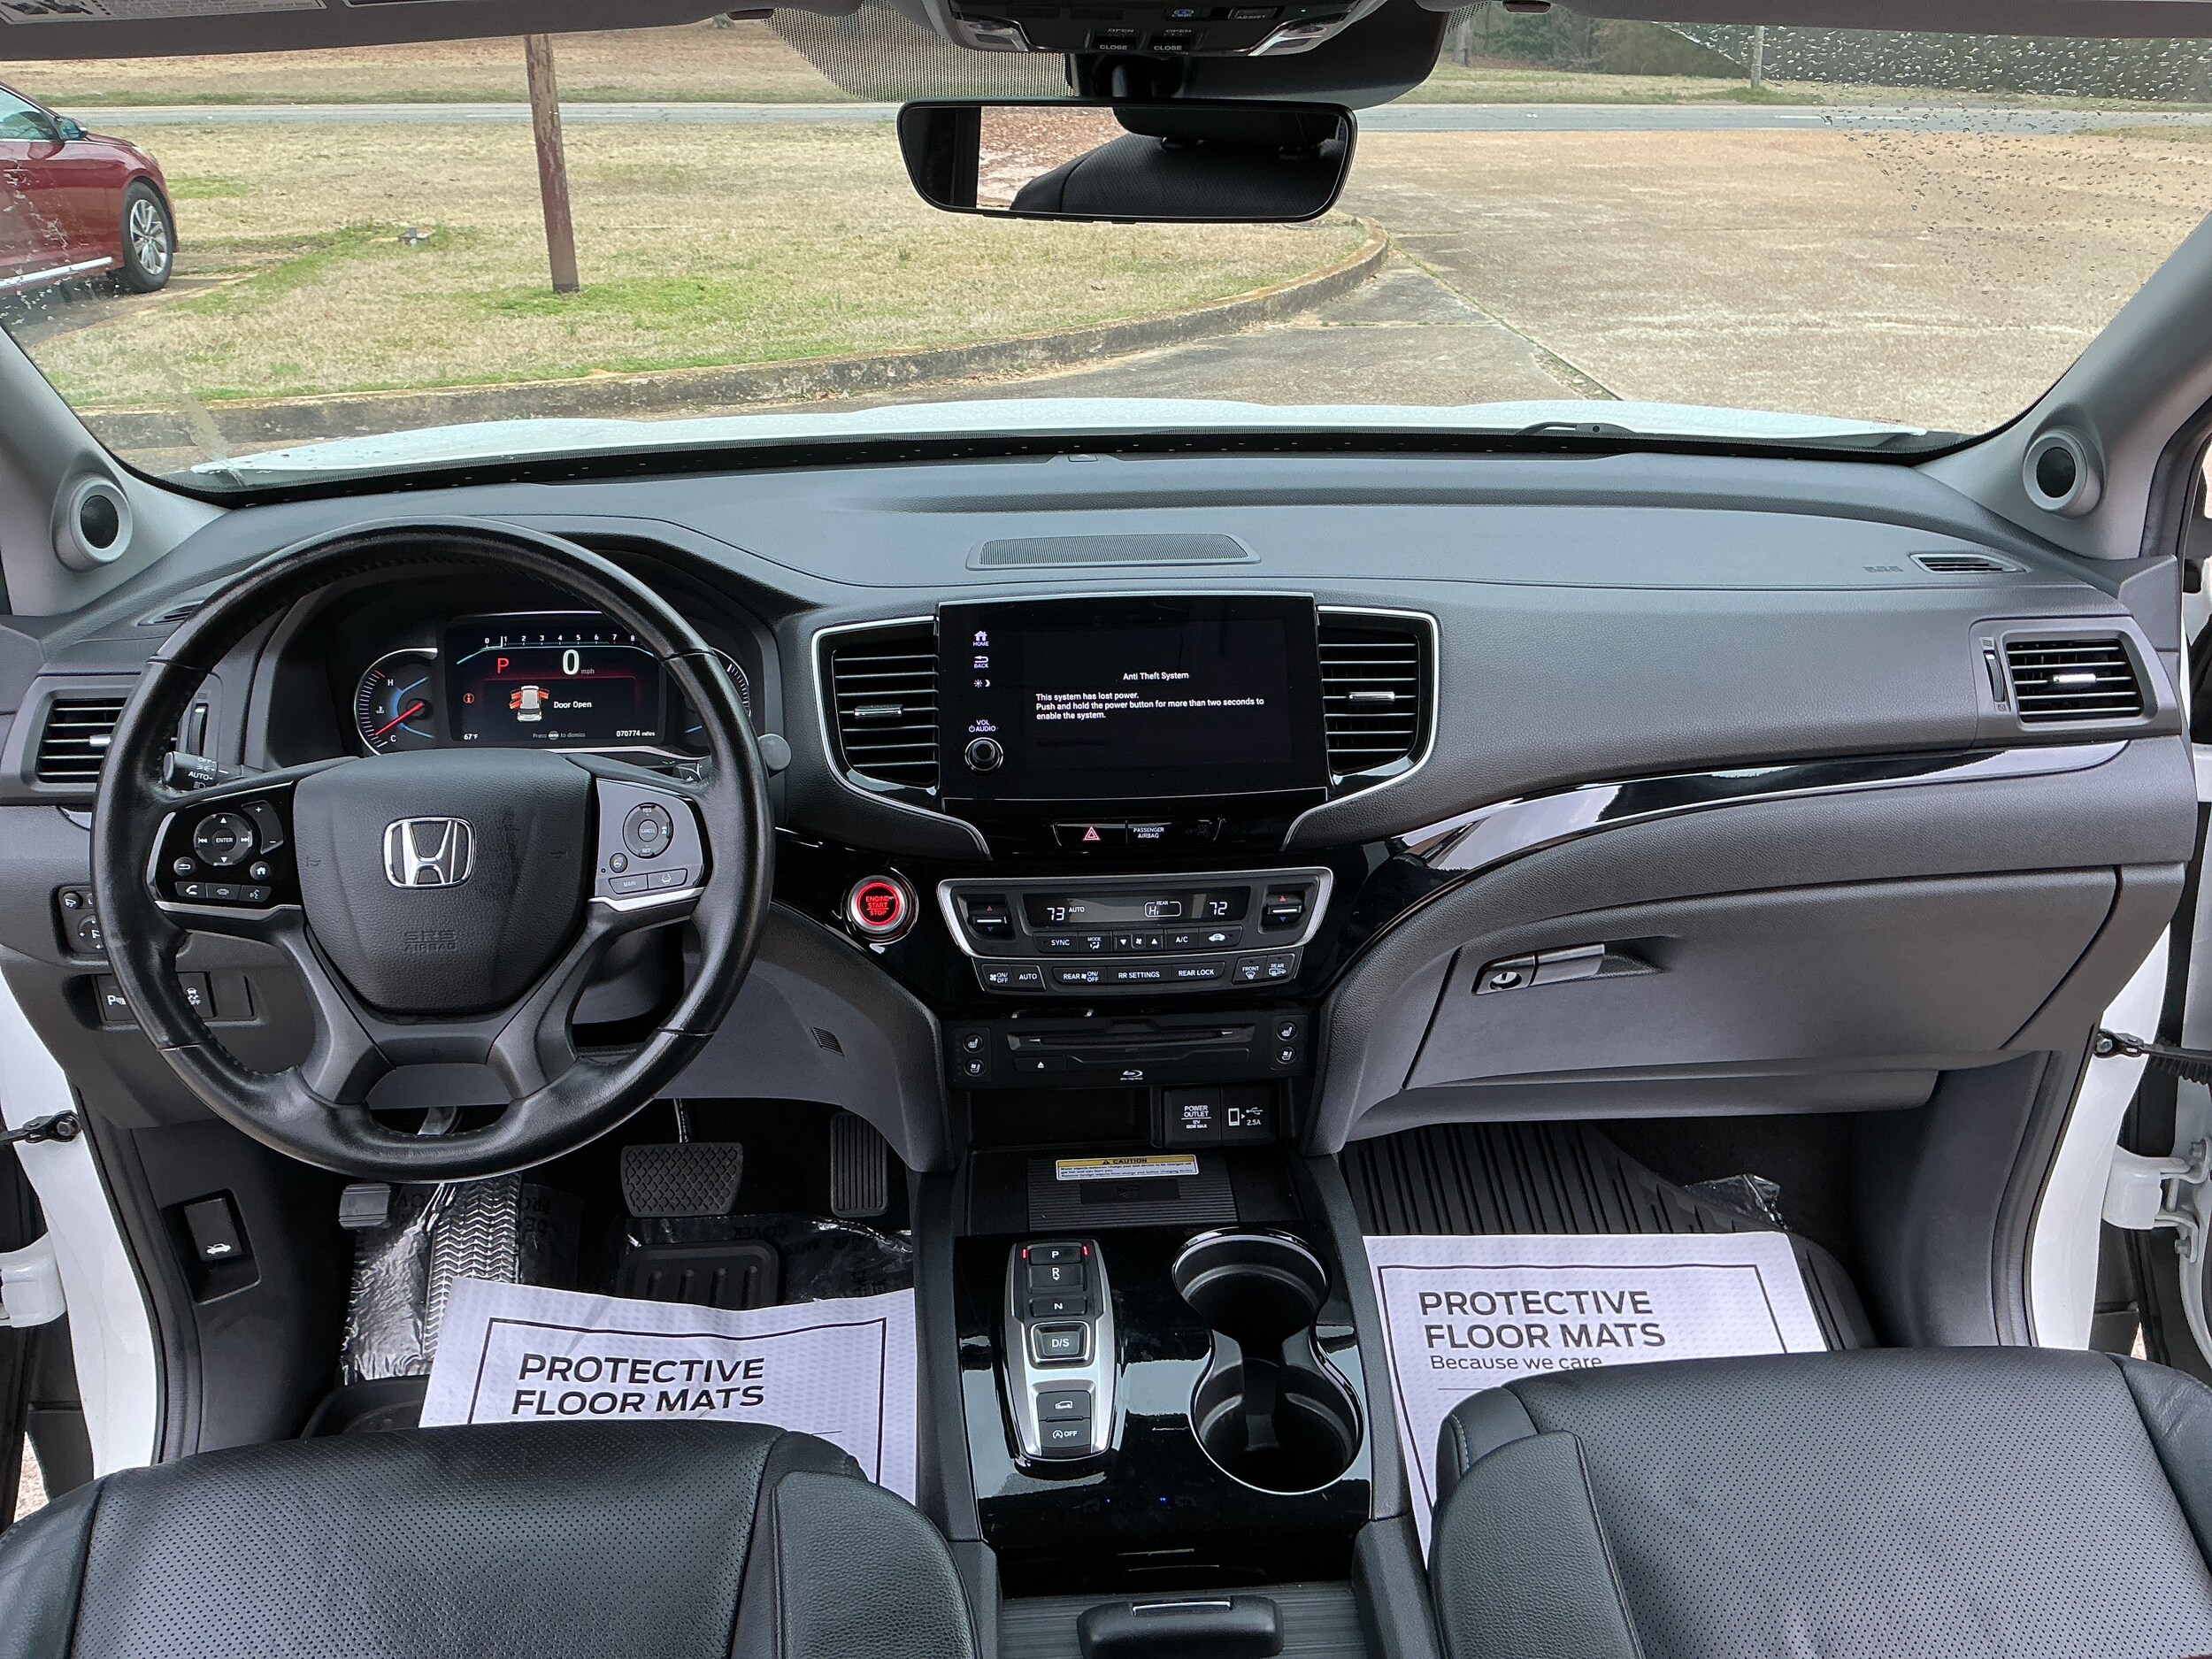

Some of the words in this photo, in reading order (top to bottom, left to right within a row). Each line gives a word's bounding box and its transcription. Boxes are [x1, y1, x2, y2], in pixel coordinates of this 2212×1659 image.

[497, 657, 510, 673] P
[563, 649, 580, 675] 0
[1140, 672, 1160, 680] Theft
[1161, 672, 1189, 680] System
[1054, 693, 1081, 703] system
[1114, 692, 1139, 701] power.
[1223, 697, 1255, 706] seconds
[572, 701, 592, 710] Open
[1077, 711, 1106, 720] system.
[188, 771, 210, 780] AUTO
[1047, 907, 1065, 921] 73
[1210, 902, 1228, 916] 72
[1051, 1250, 1059, 1259] P
[1051, 1267, 1060, 1277] R
[1418, 1290, 1654, 1316] PROTECTIVE
[1425, 1323, 1551, 1349] FLOOR
[1560, 1322, 1666, 1348] MATS
[1051, 1338, 1070, 1348] D/S
[518, 1353, 765, 1384] PROTECTIVE
[1430, 1355, 1518, 1370] Because
[1522, 1358, 1554, 1370] we
[1558, 1357, 1603, 1370] care
[511, 1388, 645, 1416] FLOOR
[655, 1385, 764, 1412] MATS
